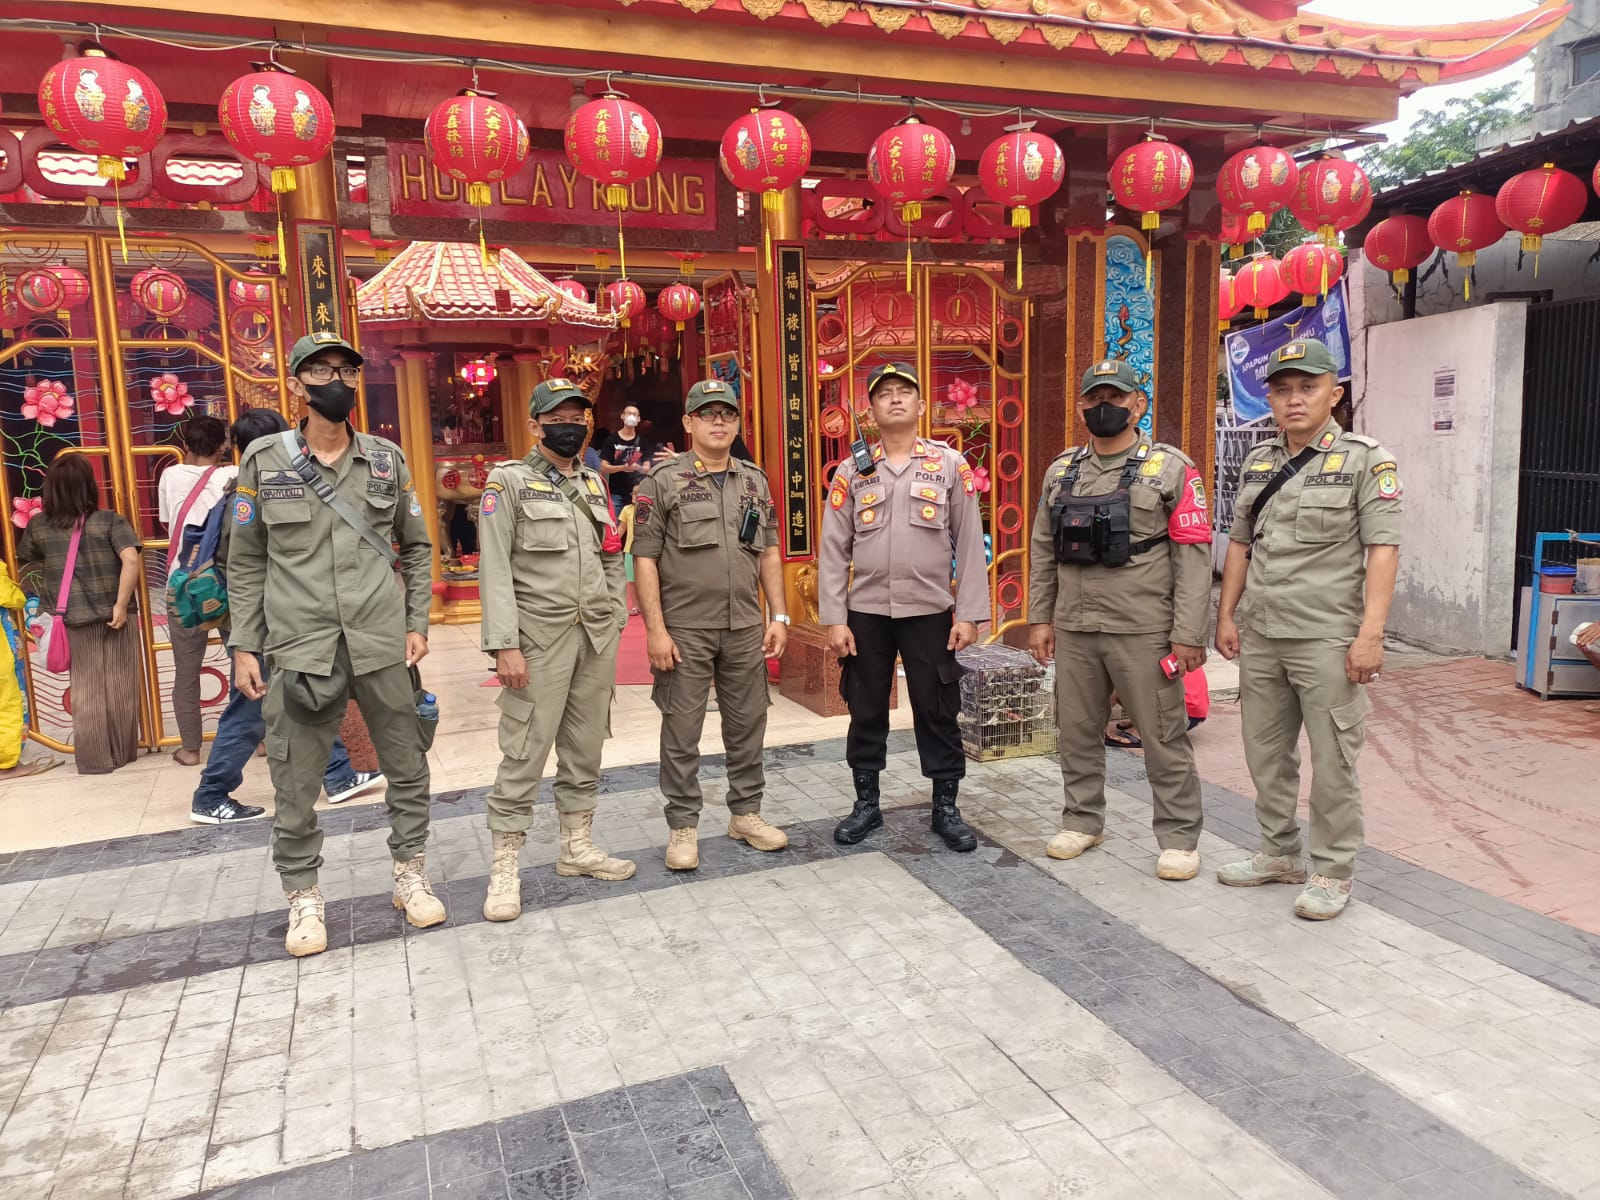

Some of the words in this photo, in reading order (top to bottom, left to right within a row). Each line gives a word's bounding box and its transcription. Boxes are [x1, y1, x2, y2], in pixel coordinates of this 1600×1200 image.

[483, 105, 502, 160] 大吉大利
[769, 116, 788, 168] 吉祥如意
[500, 162, 577, 208] LAY
[593, 171, 705, 215] KONG
[311, 255, 328, 279] 來
[785, 272, 799, 290] 福
[316, 302, 332, 326] 來
[788, 353, 800, 372] 皆
[789, 394, 800, 411] 由
[789, 437, 802, 449] 心
[791, 470, 802, 490] 中
[915, 471, 946, 484] POLRI
[1334, 476, 1350, 484] PP
[791, 511, 805, 528] 造
